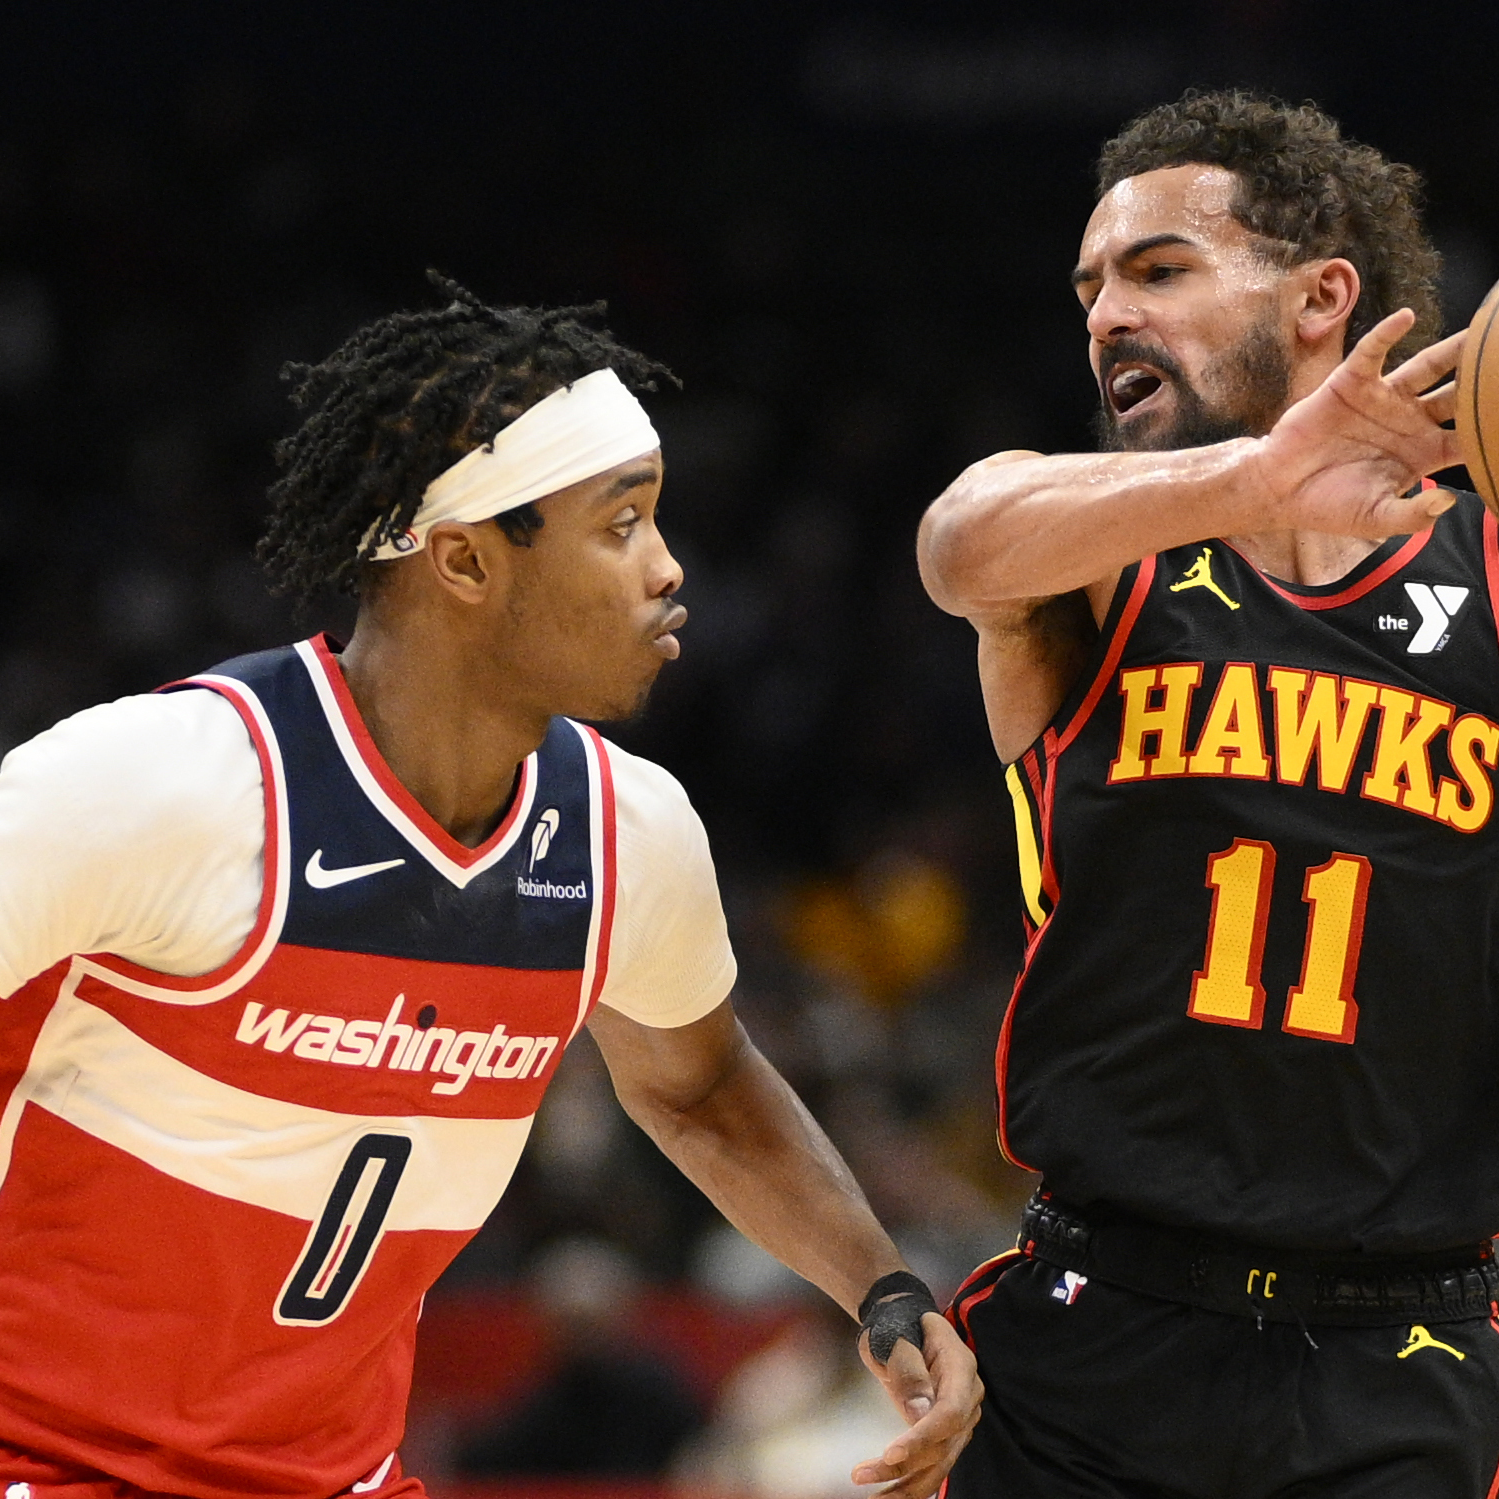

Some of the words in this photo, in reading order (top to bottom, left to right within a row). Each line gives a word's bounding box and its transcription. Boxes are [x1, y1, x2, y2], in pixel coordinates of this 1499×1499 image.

[1378, 614, 1409, 630] the
[1404, 582, 1469, 653] Y
[517, 876, 587, 899] Robinhood
[1186, 837, 1372, 1044] 11
[235, 993, 559, 1095] washington
[273, 1127, 412, 1327] 0
